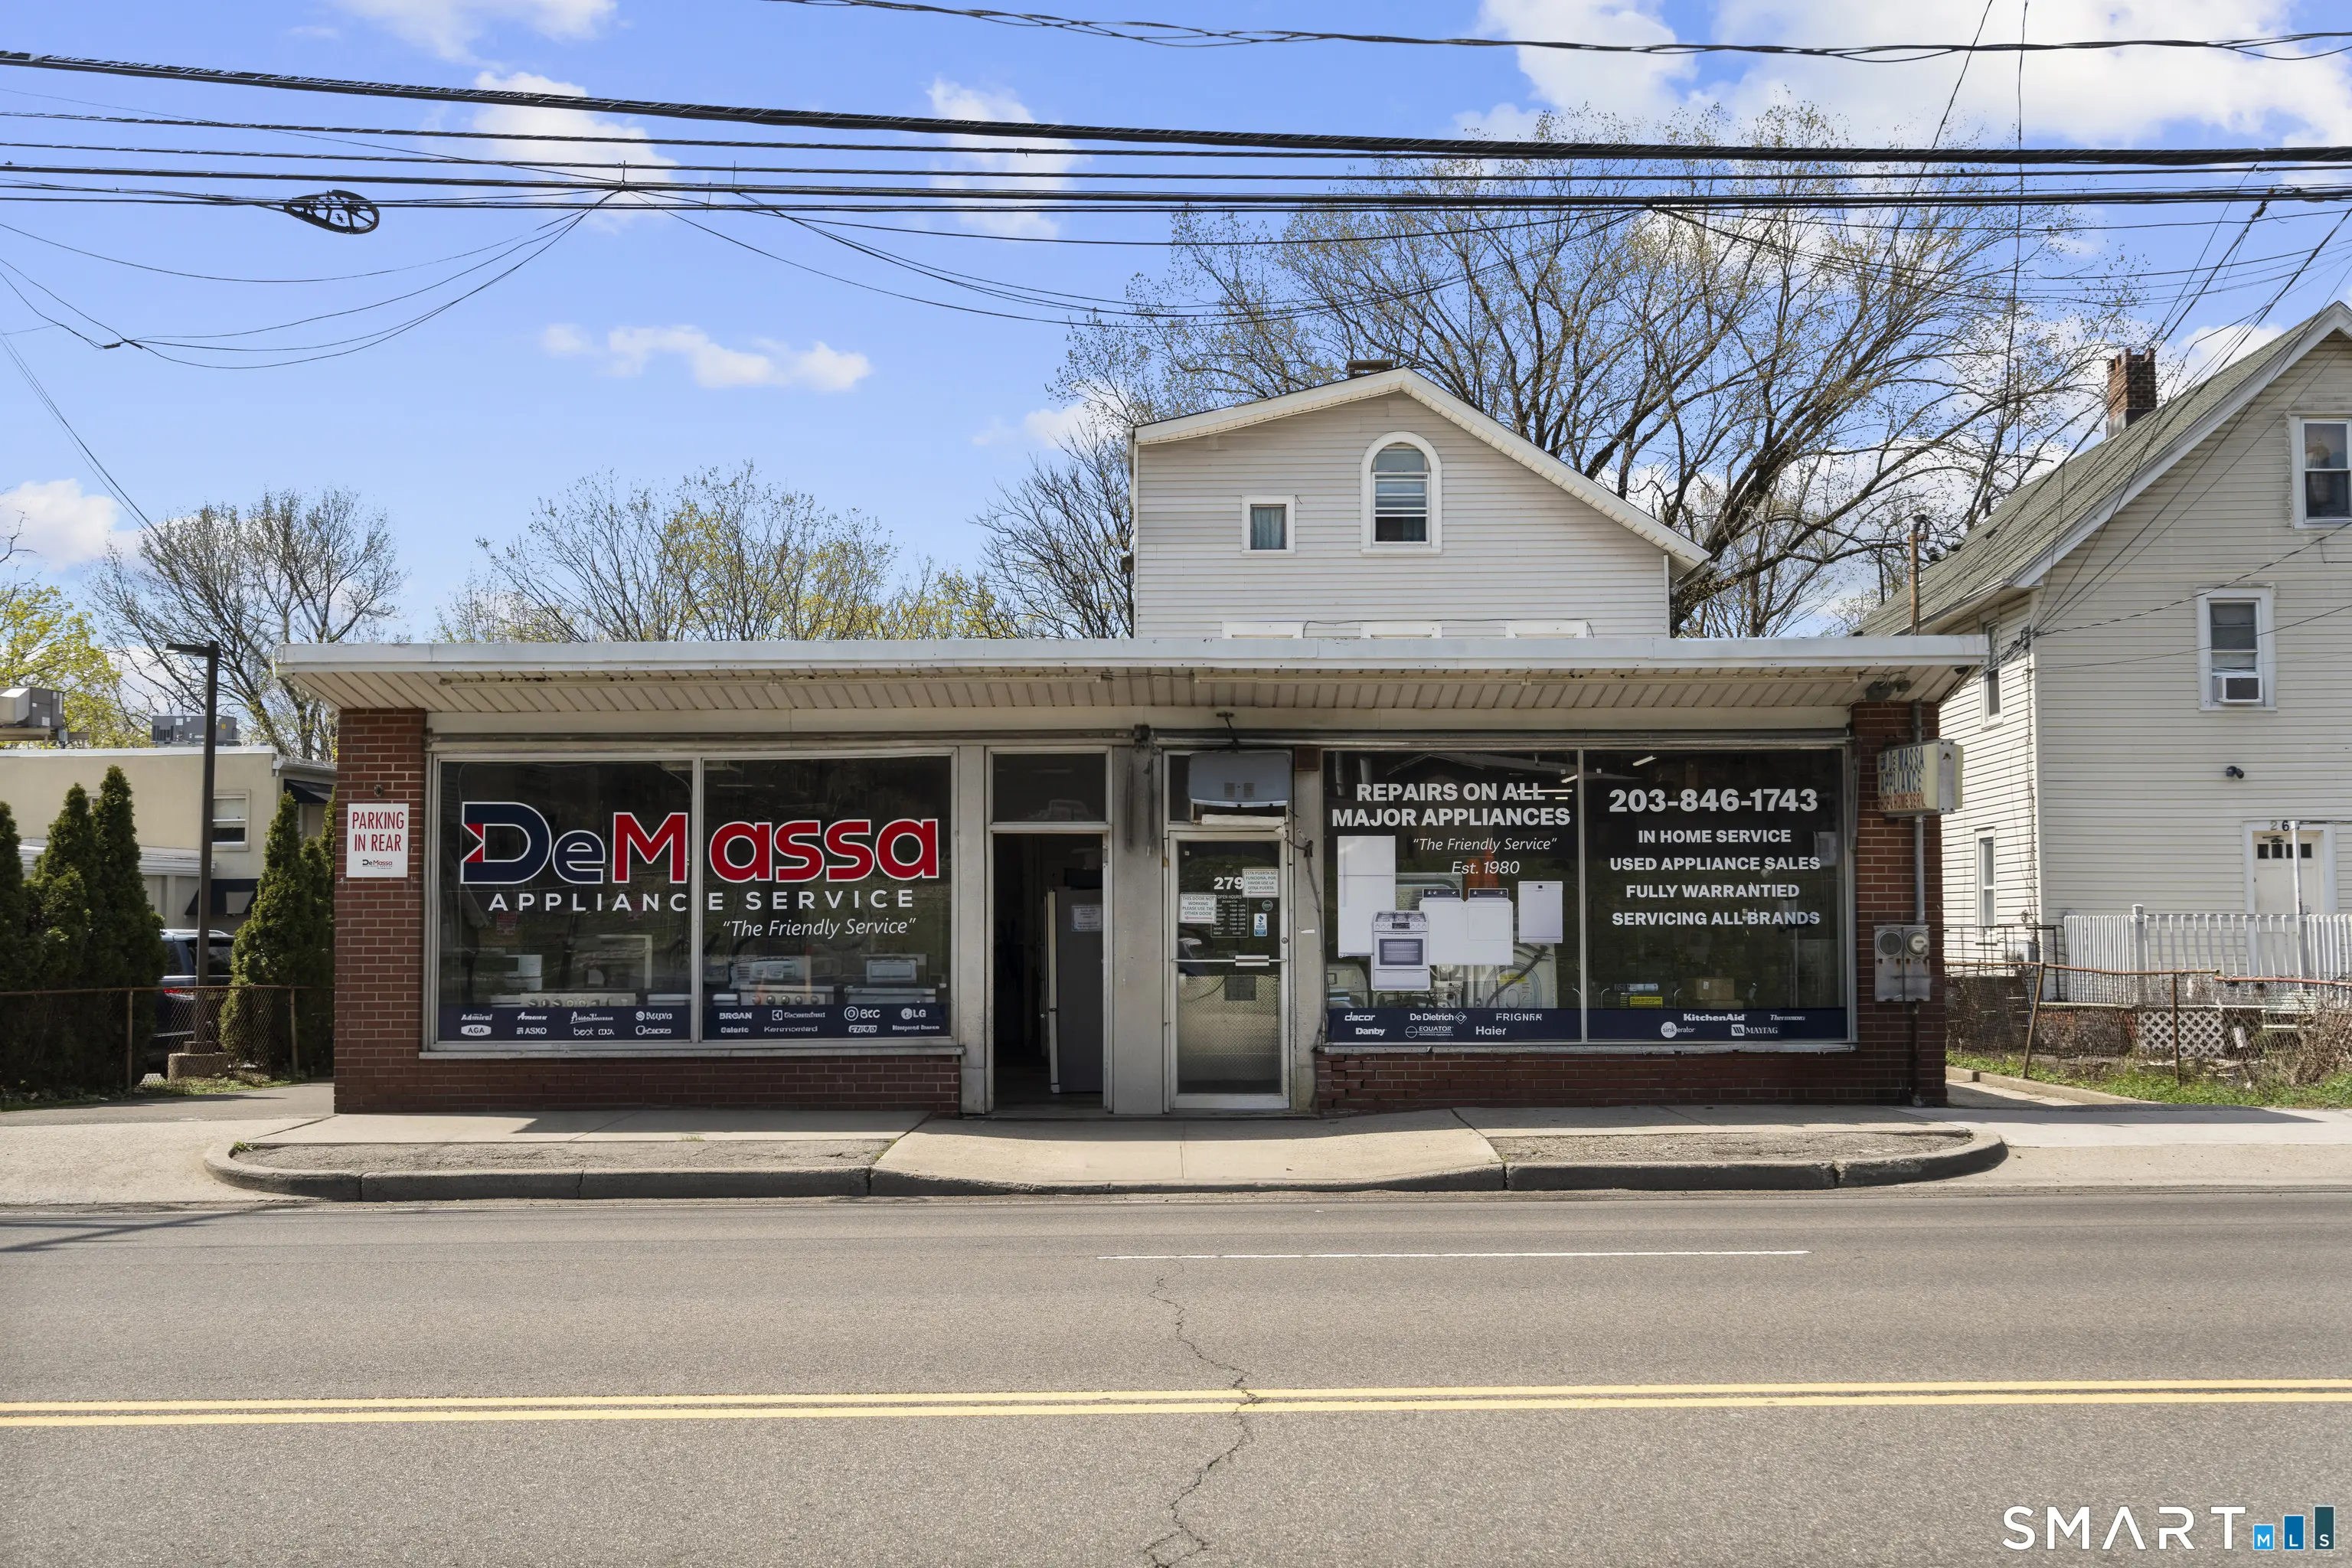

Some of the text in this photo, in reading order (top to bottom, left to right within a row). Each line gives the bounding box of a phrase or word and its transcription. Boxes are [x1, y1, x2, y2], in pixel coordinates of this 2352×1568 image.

[1881, 769, 1922, 795] APPLIANCE
[1357, 782, 1545, 802] REPAIRS ON ALL
[1609, 789, 1818, 812] 203-846-1743
[352, 812, 404, 829] PARKING
[1332, 808, 1570, 827] MAJOR APPLIANCES
[354, 834, 401, 851] IN REAR
[1638, 829, 1792, 843] IN HOME SERVICE
[1447, 837, 1501, 854] Friendly
[1452, 861, 1521, 874] Est. 1980
[1610, 857, 1821, 871] USED APPLIANCE SALES
[1214, 877, 1244, 890] 279
[1626, 884, 1799, 898] FULLY WARRANTIED
[488, 892, 724, 911] APPLIANCE
[746, 890, 913, 910] SERVICE
[1612, 912, 1820, 926] SERVICING ALL BRANDS
[769, 919, 841, 939] Friendly
[913, 1009, 926, 1018] LG
[1344, 1012, 1376, 1021] dacor
[1410, 1012, 1454, 1021] De Dietrich
[1684, 1013, 1746, 1021] KitchenAid
[1355, 1027, 1385, 1036] Danby
[1476, 1026, 1506, 1036] Haier
